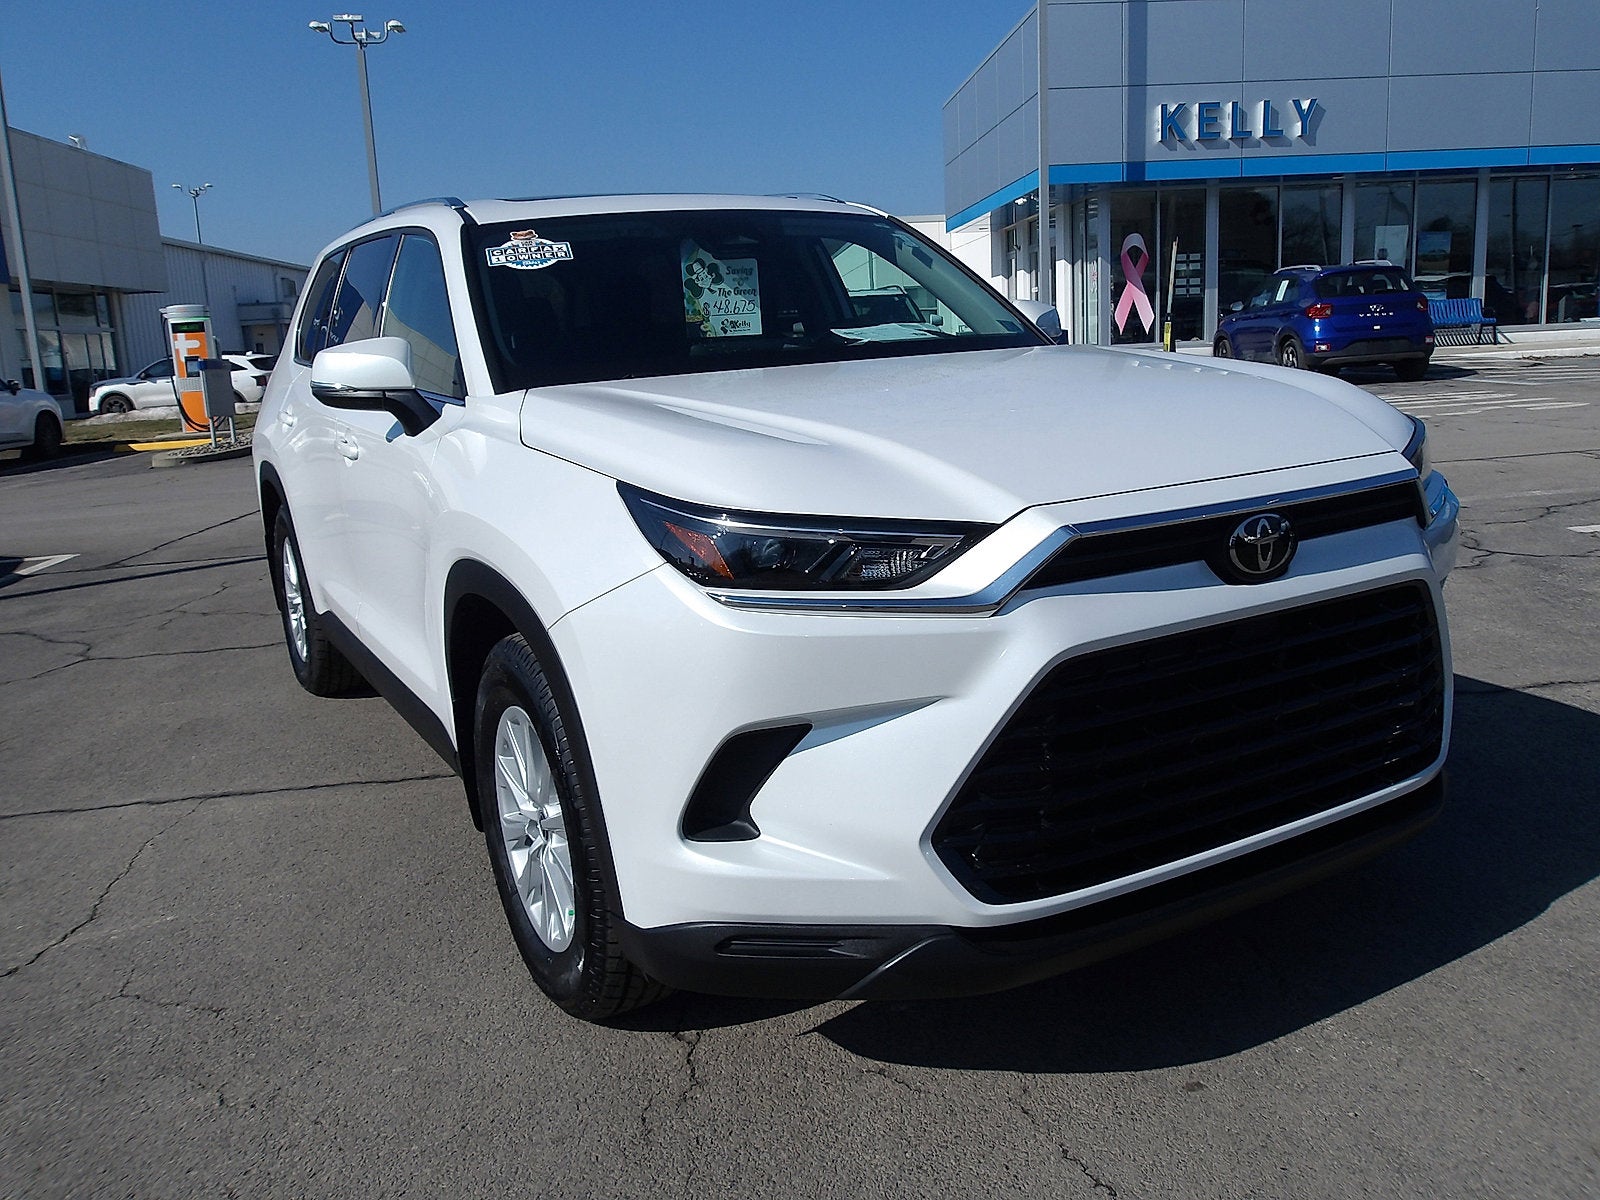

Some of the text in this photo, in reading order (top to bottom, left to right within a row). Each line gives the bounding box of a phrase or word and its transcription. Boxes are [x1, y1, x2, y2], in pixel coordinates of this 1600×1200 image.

[1158, 98, 1318, 142] KELLY
[491, 245, 566, 256] CARFAX
[506, 251, 567, 262] OWNER
[718, 286, 757, 298] The Green
